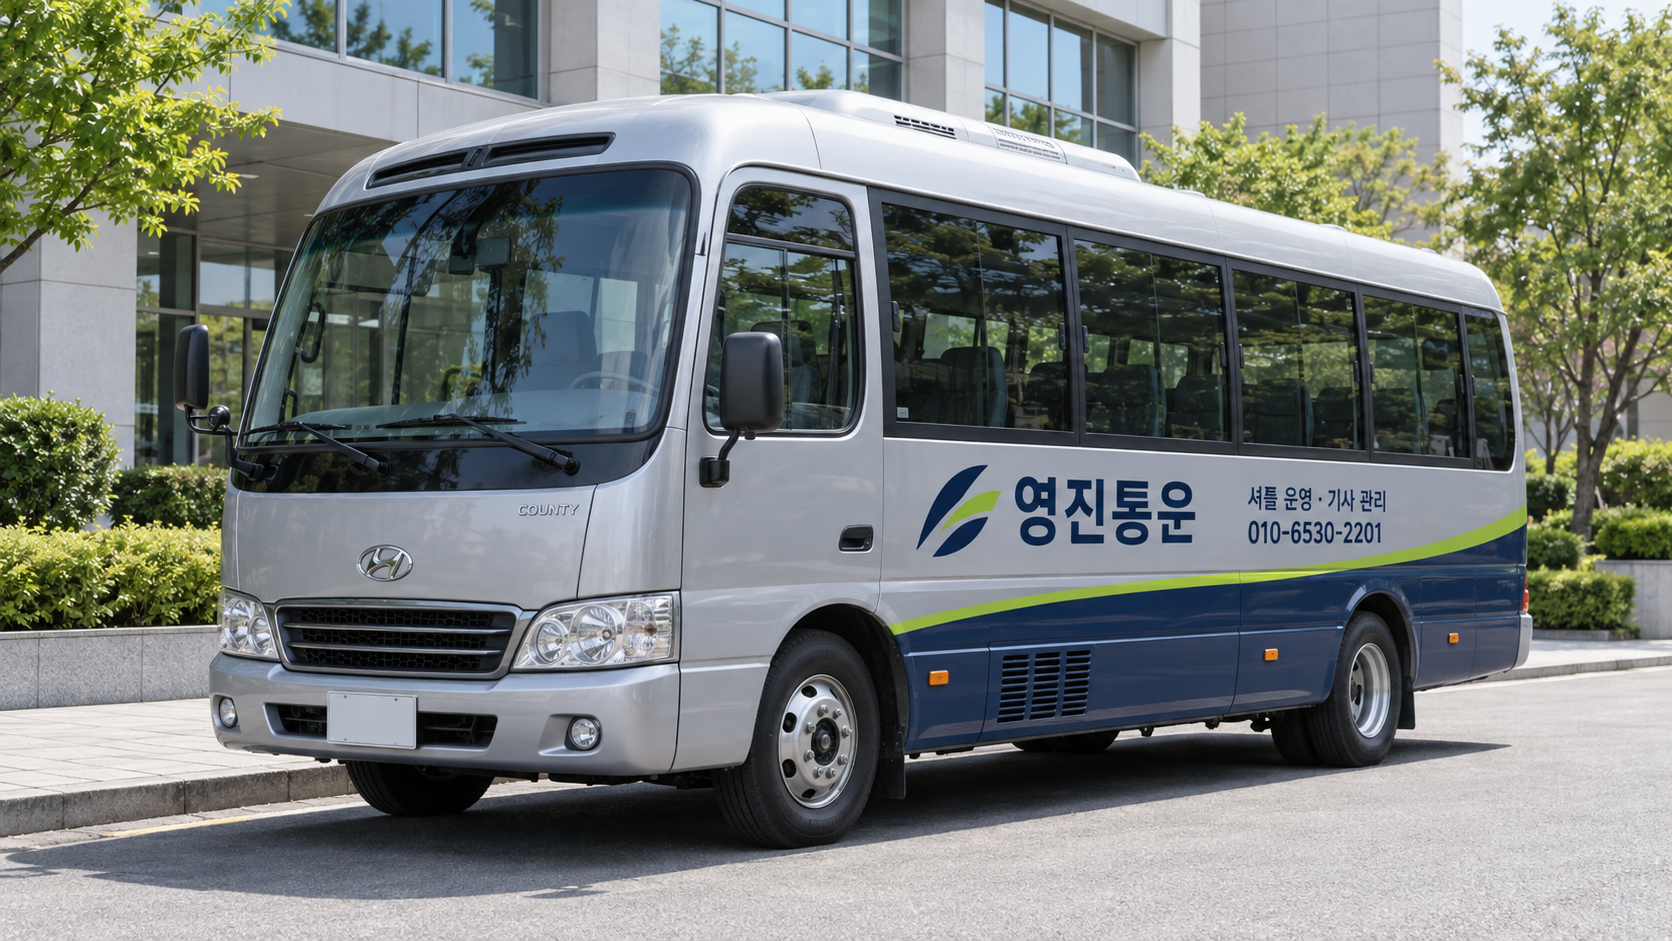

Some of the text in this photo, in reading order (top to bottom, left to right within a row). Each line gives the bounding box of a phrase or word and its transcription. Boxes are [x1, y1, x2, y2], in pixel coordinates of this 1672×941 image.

[517, 504, 580, 516] COUNTY
[1014, 475, 1197, 547] 영진통운
[1247, 485, 1278, 511] 셔틀
[1283, 486, 1312, 512] 운영
[1327, 488, 1356, 513] 기사
[1359, 489, 1386, 513] 관리
[1247, 519, 1382, 545] 010-6530-2201
